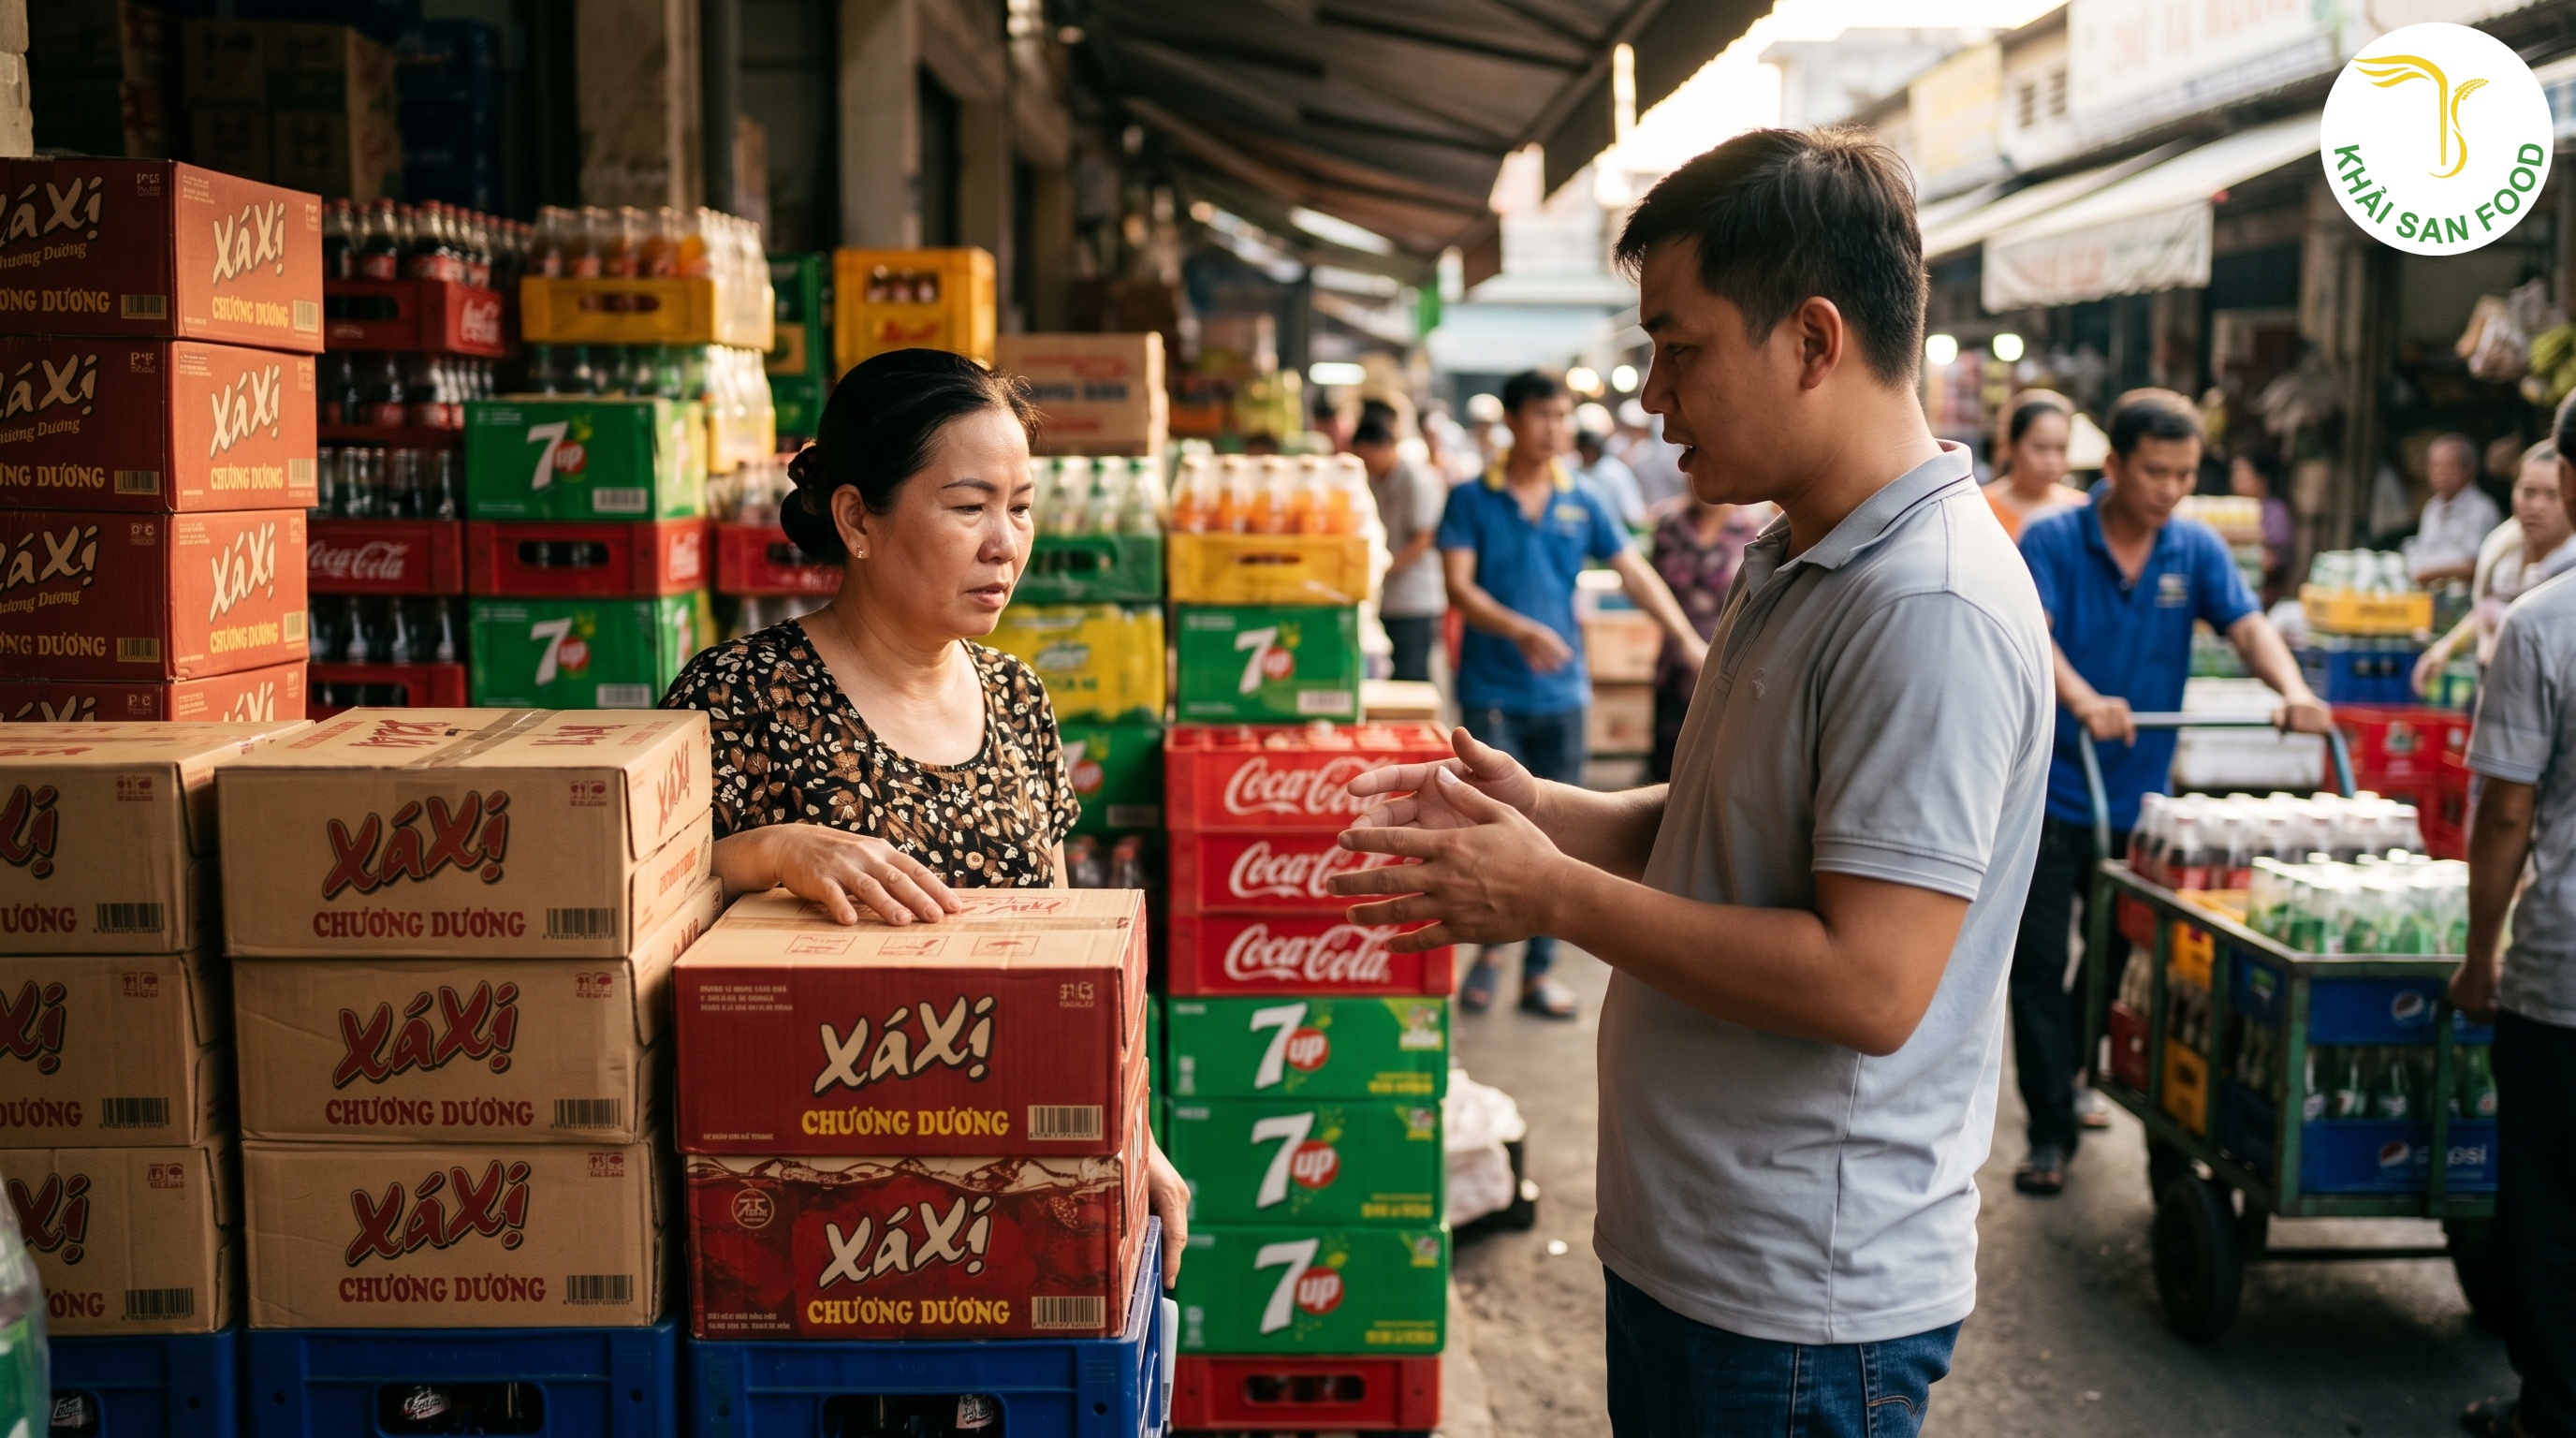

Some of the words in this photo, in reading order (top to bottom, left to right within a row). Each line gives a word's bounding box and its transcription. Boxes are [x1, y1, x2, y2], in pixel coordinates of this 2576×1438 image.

[41, 286, 110, 314] DƯƠNG
[0, 353, 98, 419] áXị
[37, 462, 105, 489] DƯƠNG
[0, 525, 99, 592] áXị
[37, 631, 107, 657] DƯƠNG
[0, 902, 78, 934] ƯƠNG
[312, 905, 424, 938] CHƯƠNG
[431, 905, 526, 938] DƯƠNG
[325, 1094, 435, 1126] CHƯƠNG
[441, 1095, 534, 1127] DƯƠNG
[801, 1106, 912, 1137] CHƯƠNG
[916, 1106, 1010, 1137] DƯƠNG
[338, 1272, 448, 1303] CHƯƠNG
[454, 1272, 547, 1303] DƯƠNG
[806, 1295, 915, 1326] CHƯƠNG
[920, 1295, 1011, 1326] DƯƠNG
